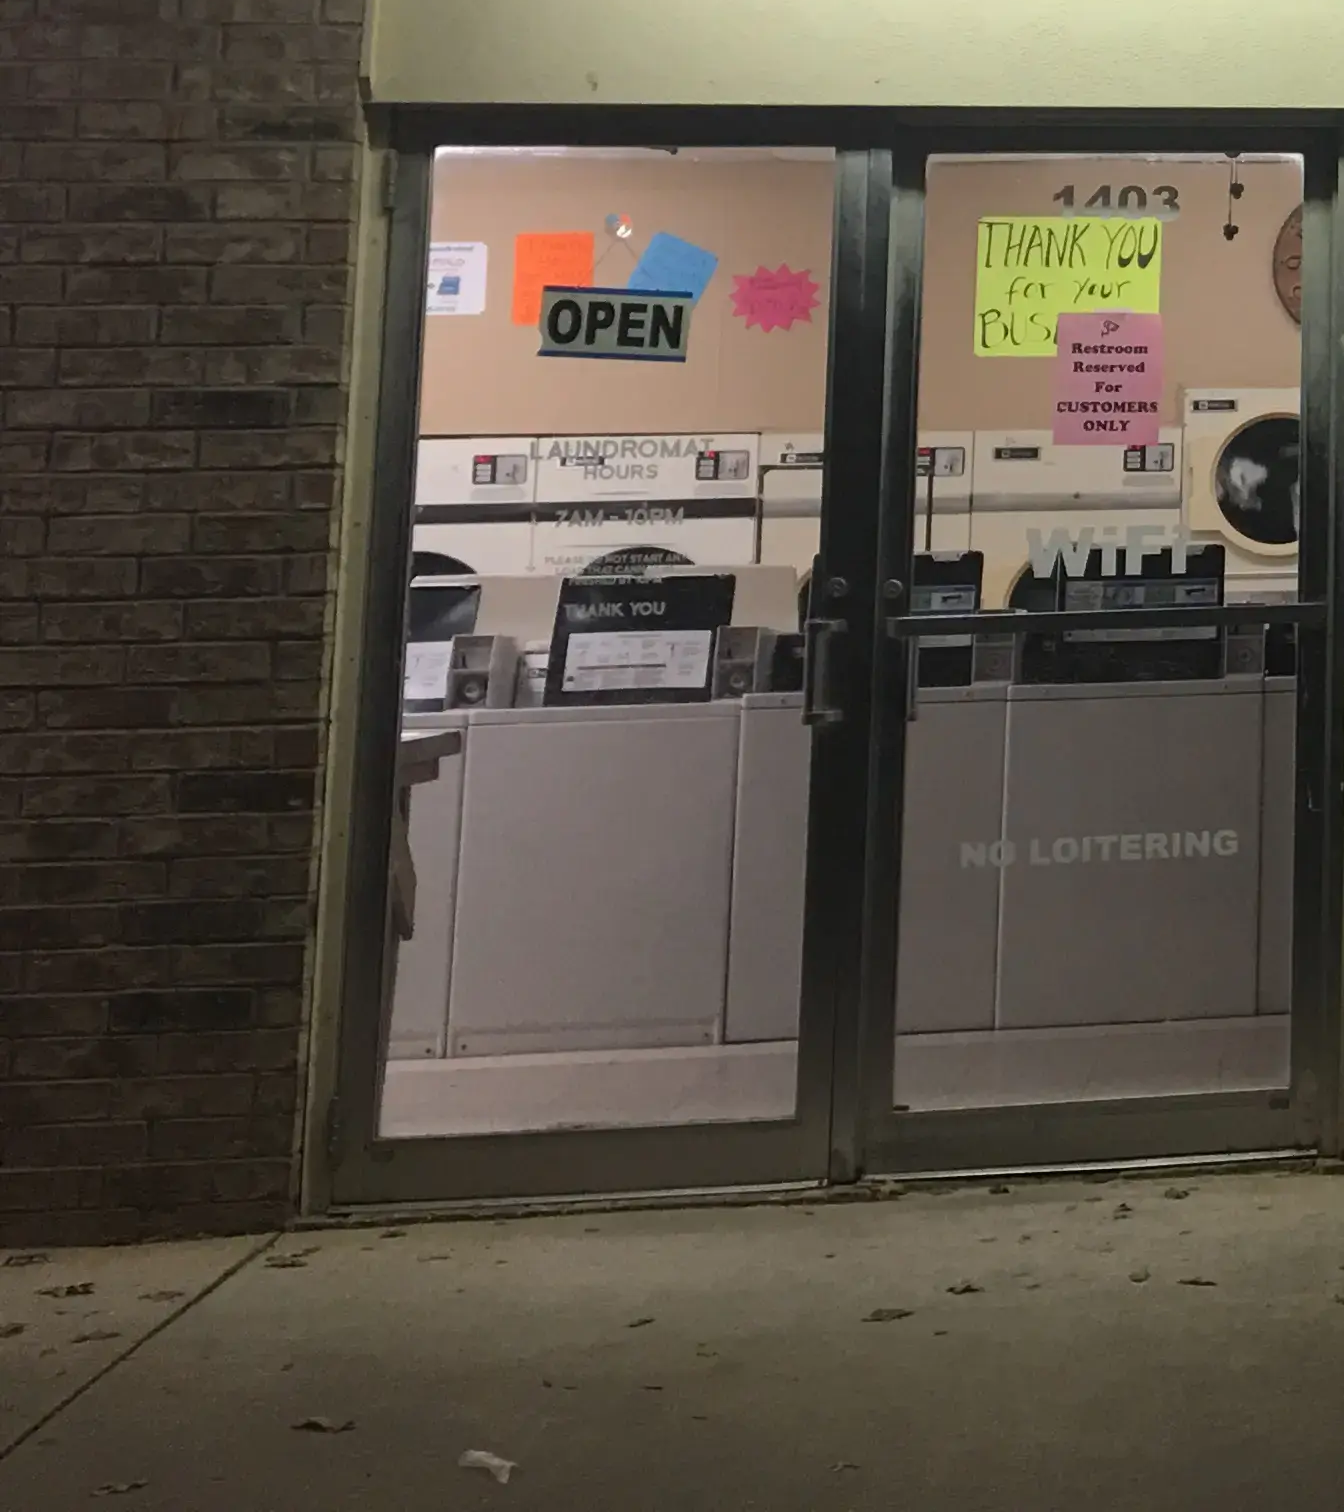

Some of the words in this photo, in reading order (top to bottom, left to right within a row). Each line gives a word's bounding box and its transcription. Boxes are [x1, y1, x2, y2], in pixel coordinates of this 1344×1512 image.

[1053, 185, 1180, 222] 1403
[979, 221, 1092, 269] THANK
[1100, 223, 1159, 269] YOU
[1005, 276, 1049, 300] for
[1074, 277, 1131, 303] your
[546, 299, 684, 349] OPEN
[1072, 343, 1148, 354] Restroom
[1073, 361, 1145, 373] Reserved
[1094, 381, 1122, 393] For
[1057, 401, 1158, 413] CUSTOMERS
[1083, 420, 1131, 432] ONLY
[530, 438, 715, 460] LAUNDROMAT
[583, 464, 659, 480] HOURS
[555, 509, 604, 527] 7AM
[625, 507, 685, 526] 10PM
[564, 603, 624, 619] THANK
[629, 601, 666, 616] YOU
[960, 841, 1016, 869] NO
[1029, 829, 1239, 866] LOITERING
